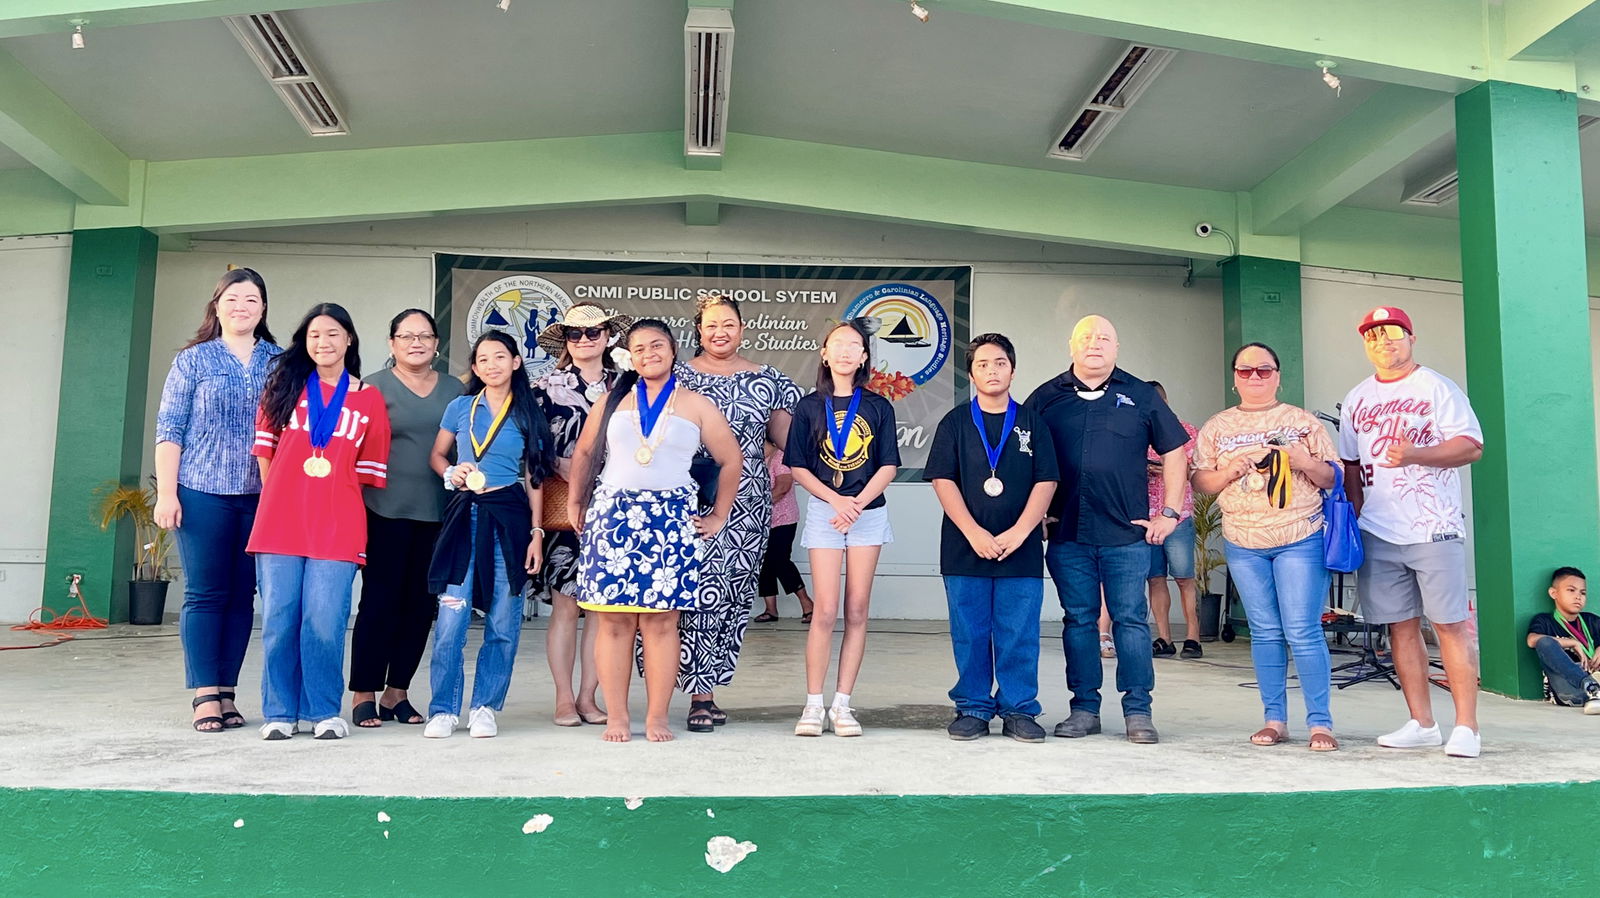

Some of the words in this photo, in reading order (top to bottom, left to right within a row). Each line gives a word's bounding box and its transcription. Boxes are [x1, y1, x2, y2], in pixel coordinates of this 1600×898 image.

[575, 285, 622, 299] CNMI
[627, 286, 692, 300] PUBLIC
[776, 290, 837, 304] SYTEM
[881, 287, 919, 296] Carolinian
[470, 291, 493, 339] COMMONWEALTH
[493, 285, 503, 293] OF
[504, 280, 517, 288] THE
[519, 280, 553, 294] NORTHERN
[847, 293, 873, 320] Chamorro
[919, 293, 944, 320] Language
[755, 333, 819, 351] Studies
[940, 320, 948, 352] Heritage
[925, 352, 944, 375] Studies
